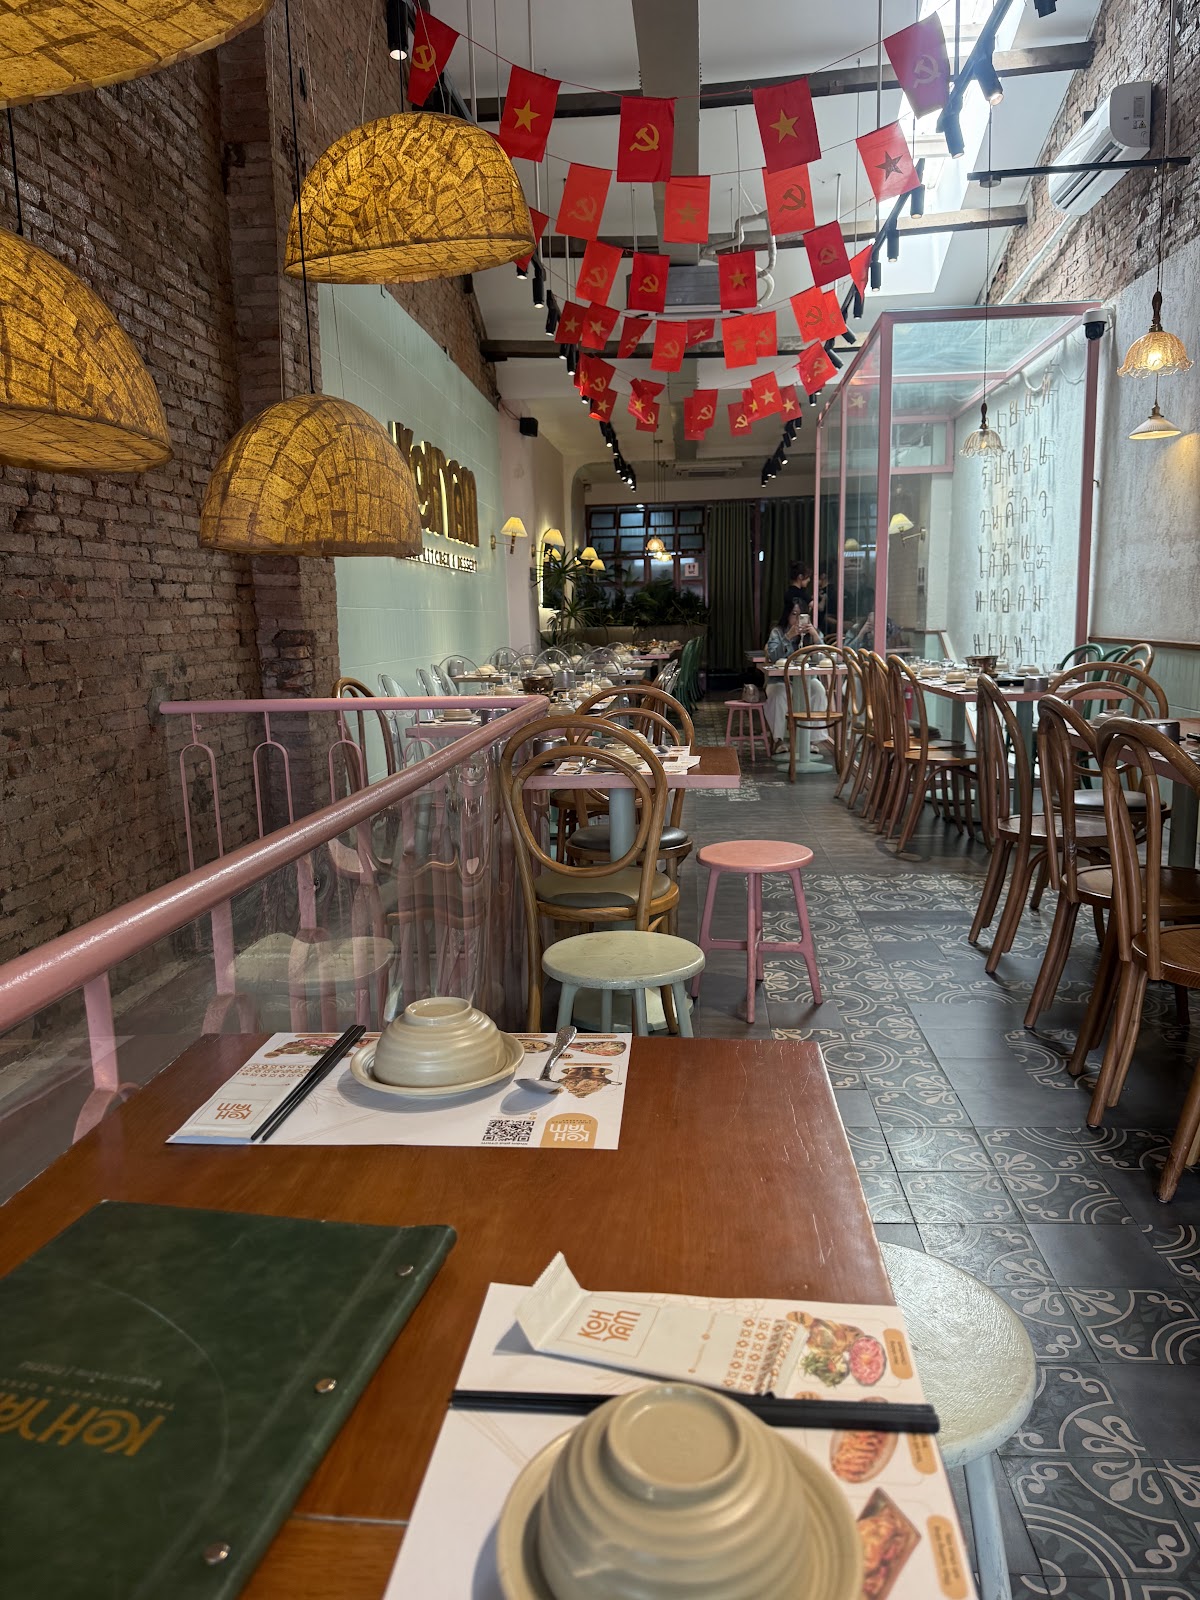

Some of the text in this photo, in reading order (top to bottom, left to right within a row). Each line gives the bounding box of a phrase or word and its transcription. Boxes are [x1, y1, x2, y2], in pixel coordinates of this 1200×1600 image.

[217, 1103, 252, 1111] YAM
[215, 1110, 252, 1120] KOH
[549, 1124, 590, 1134] YAM
[553, 1132, 590, 1142] KOH
[577, 1309, 614, 1341] KOH
[602, 1310, 641, 1342] YAM
